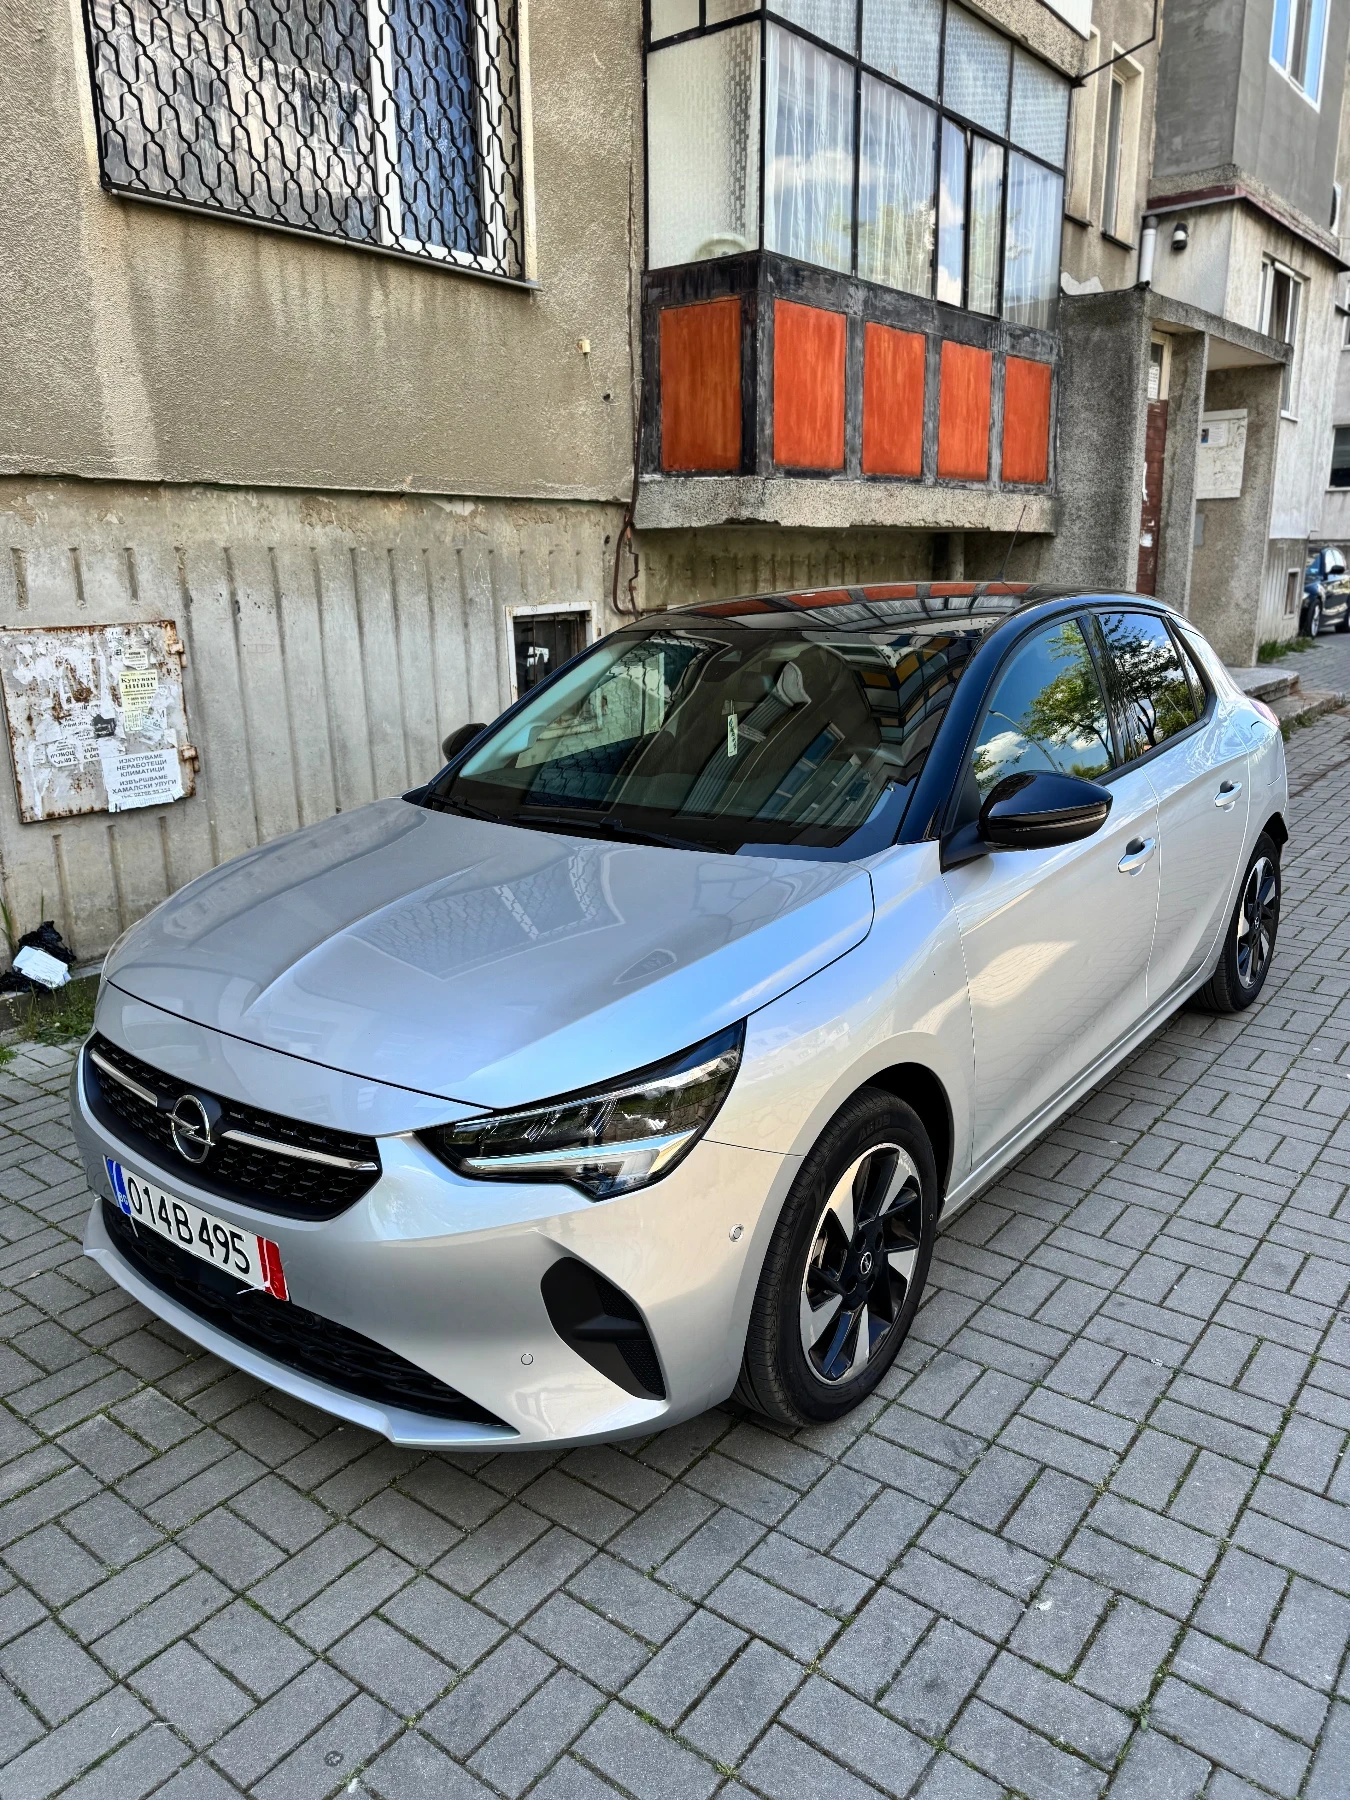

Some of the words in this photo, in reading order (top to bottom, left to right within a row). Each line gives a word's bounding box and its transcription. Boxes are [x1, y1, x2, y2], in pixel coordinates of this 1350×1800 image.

[121, 676, 156, 684] Купувам
[118, 753, 164, 764] ИЗКУПУВАМЕ
[116, 759, 167, 771] НЕРАБОТЕЩИ
[120, 766, 165, 777] КЛИМАТИЦИ
[119, 774, 168, 786] ИЗВЪРШВАМЕ
[112, 783, 153, 794] ХАМАЛСКИ
[118, 1192, 129, 1206] BG
